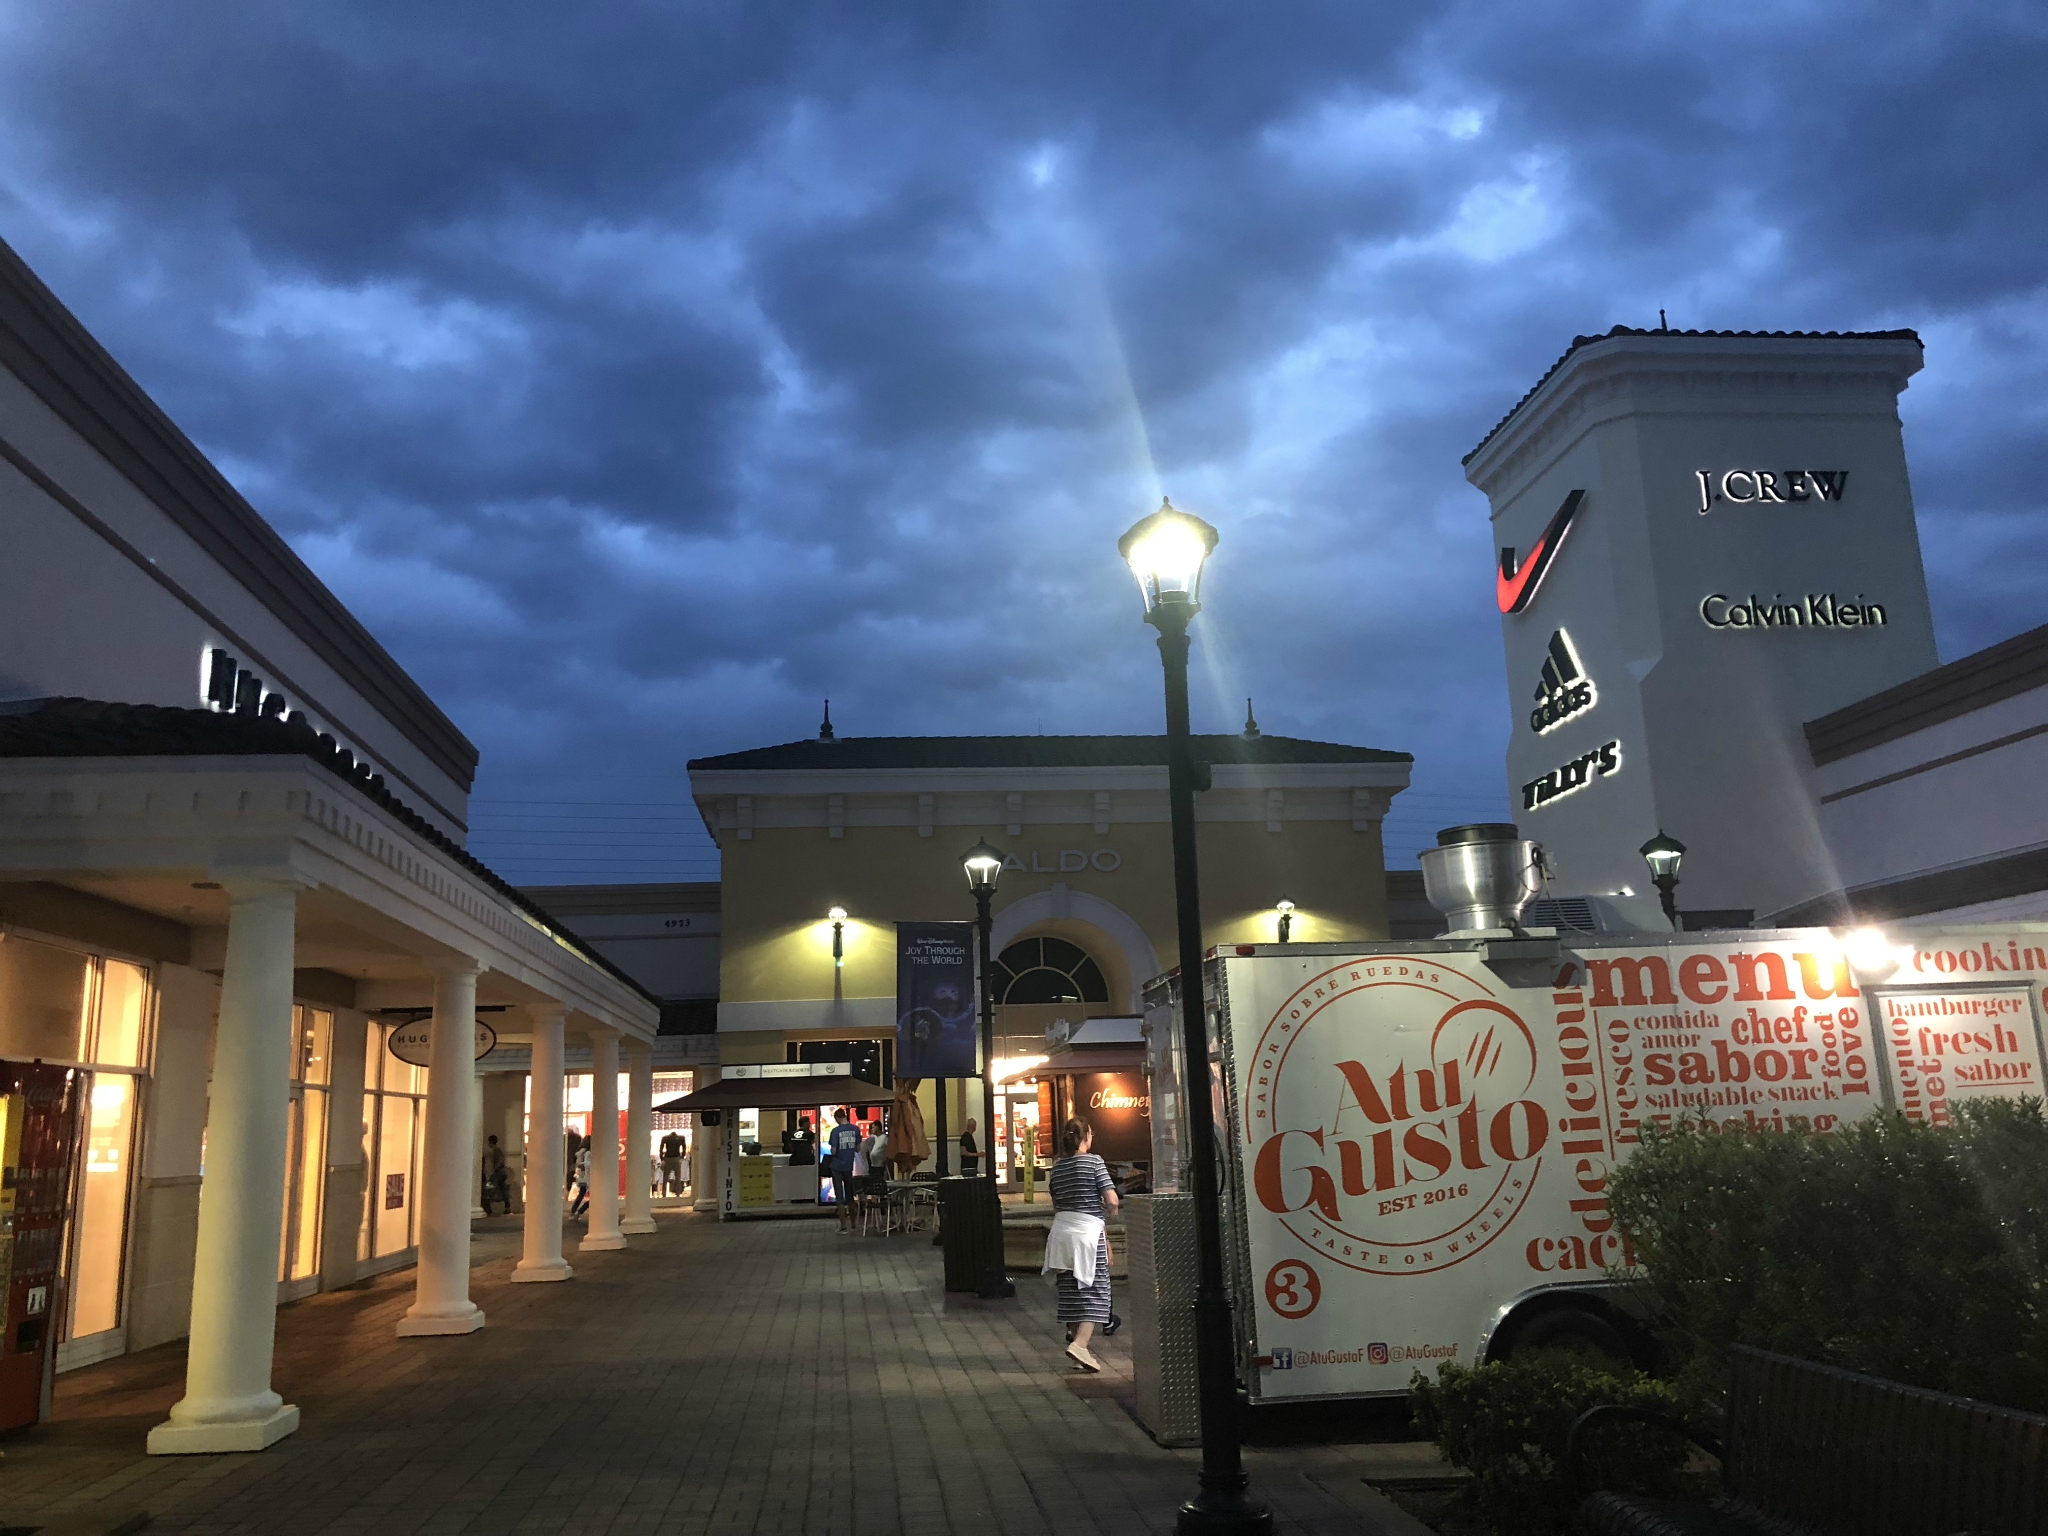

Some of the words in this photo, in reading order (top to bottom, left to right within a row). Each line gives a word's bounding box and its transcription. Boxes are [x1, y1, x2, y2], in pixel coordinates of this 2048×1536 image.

[1696, 469, 1850, 515] J.CREW
[1700, 593, 1804, 628] Calvin
[1809, 592, 1888, 627] Klein
[1000, 848, 1121, 873] ALDO
[905, 946, 922, 955] JOY
[924, 945, 966, 955] THROUGH
[911, 956, 930, 965] THE
[931, 955, 963, 965] WORLD
[1913, 940, 2048, 974] cookin
[1588, 952, 1860, 1008] menu
[1633, 1010, 1721, 1031] comida
[1730, 1006, 1809, 1046] chef
[1887, 997, 2023, 1018] hamburger
[397, 1034, 429, 1044] HUG
[1256, 1043, 1280, 1119] SABOR
[1280, 979, 1340, 1033] SOBRE
[1349, 966, 1440, 984] RUEDAS
[1641, 1033, 1701, 1049] amor
[1813, 1012, 1842, 1079] food
[1838, 1007, 1871, 1096] love
[1918, 1023, 2019, 1057] fresh
[1607, 1018, 1641, 1144] fresco
[1642, 1040, 1819, 1085] sabor
[1890, 1017, 1924, 1120] mento
[1954, 1058, 2032, 1082] sabor
[1551, 961, 1616, 1233] delicious
[1645, 1086, 1764, 1109] saludable
[1767, 1081, 1840, 1102] snack
[1917, 1058, 1951, 1129] met
[726, 1107, 734, 1162] URIST
[1254, 1090, 1549, 1222] Gusto
[1377, 1194, 1419, 1216] EST
[1423, 1183, 1469, 1206] 2016
[1310, 1226, 1389, 1265] TASTE
[1404, 1251, 1434, 1265] ON
[1446, 1177, 1524, 1254] WHEELS
